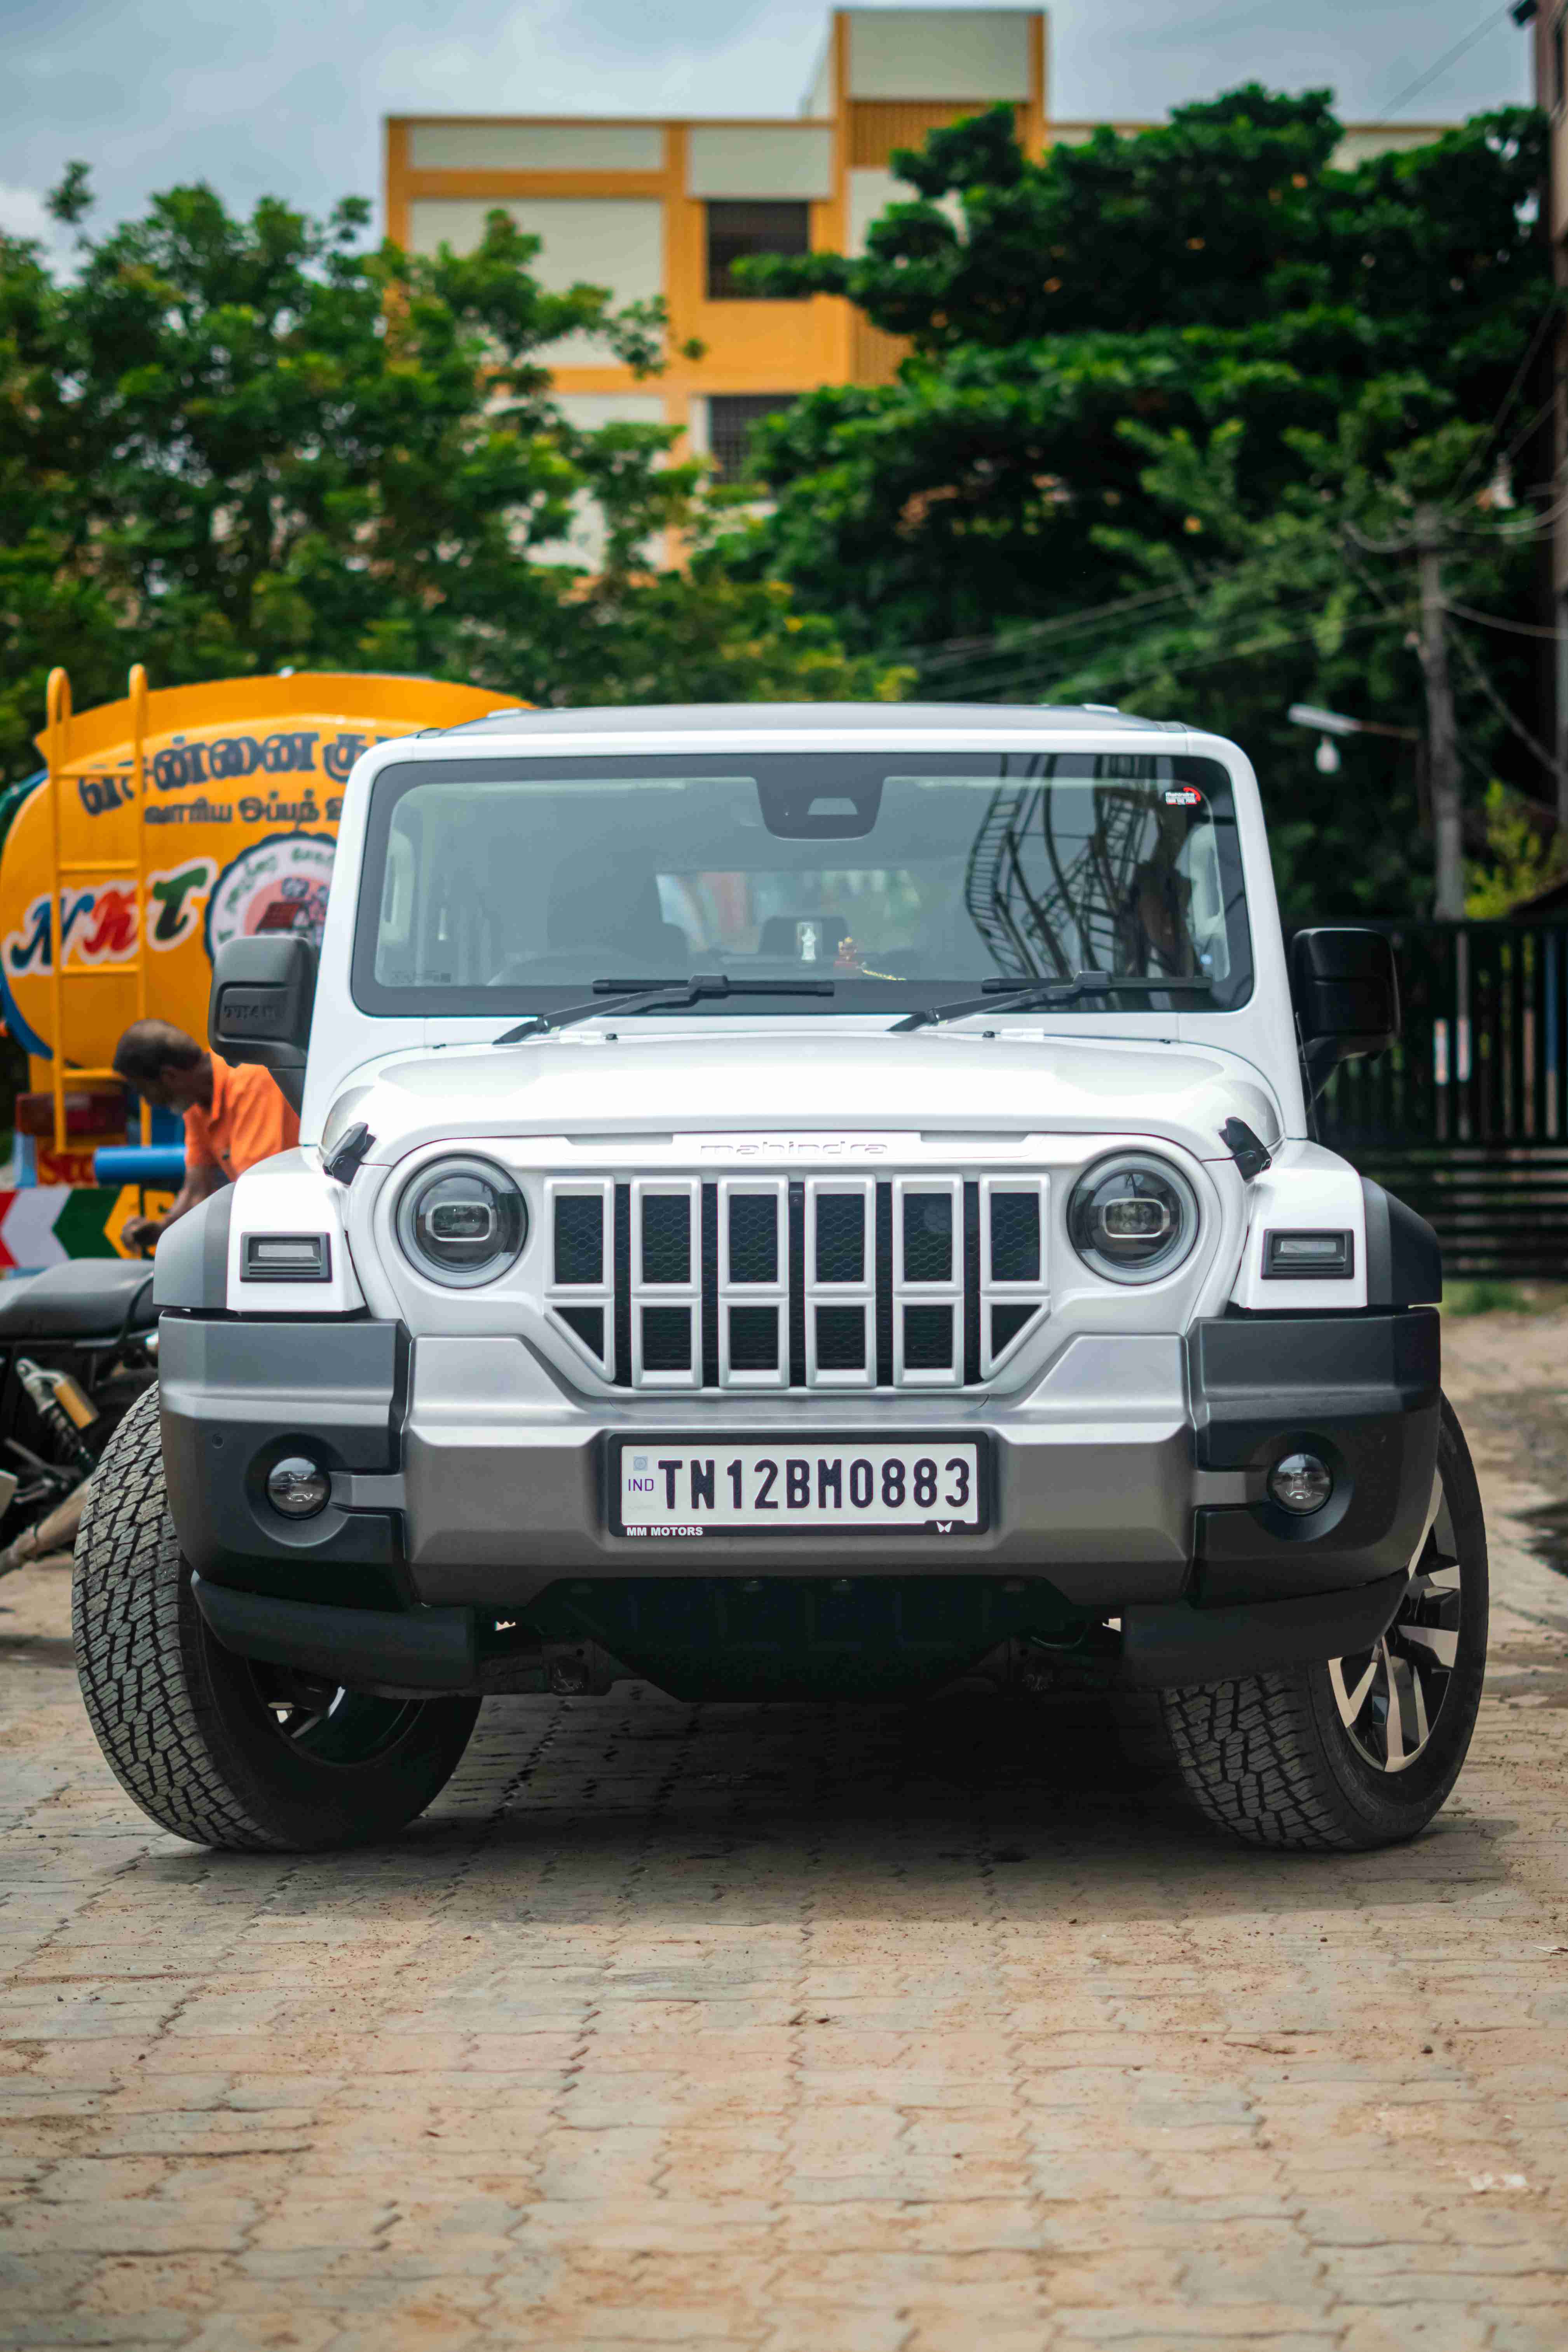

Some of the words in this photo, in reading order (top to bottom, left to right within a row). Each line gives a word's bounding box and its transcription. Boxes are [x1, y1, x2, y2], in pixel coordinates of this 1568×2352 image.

[700, 1141, 888, 1155] mahindra
[628, 1478, 654, 1492] IND
[658, 1457, 970, 1509] TN12BM0883
[626, 1527, 647, 1536] MM
[651, 1527, 703, 1536] MOTORS
